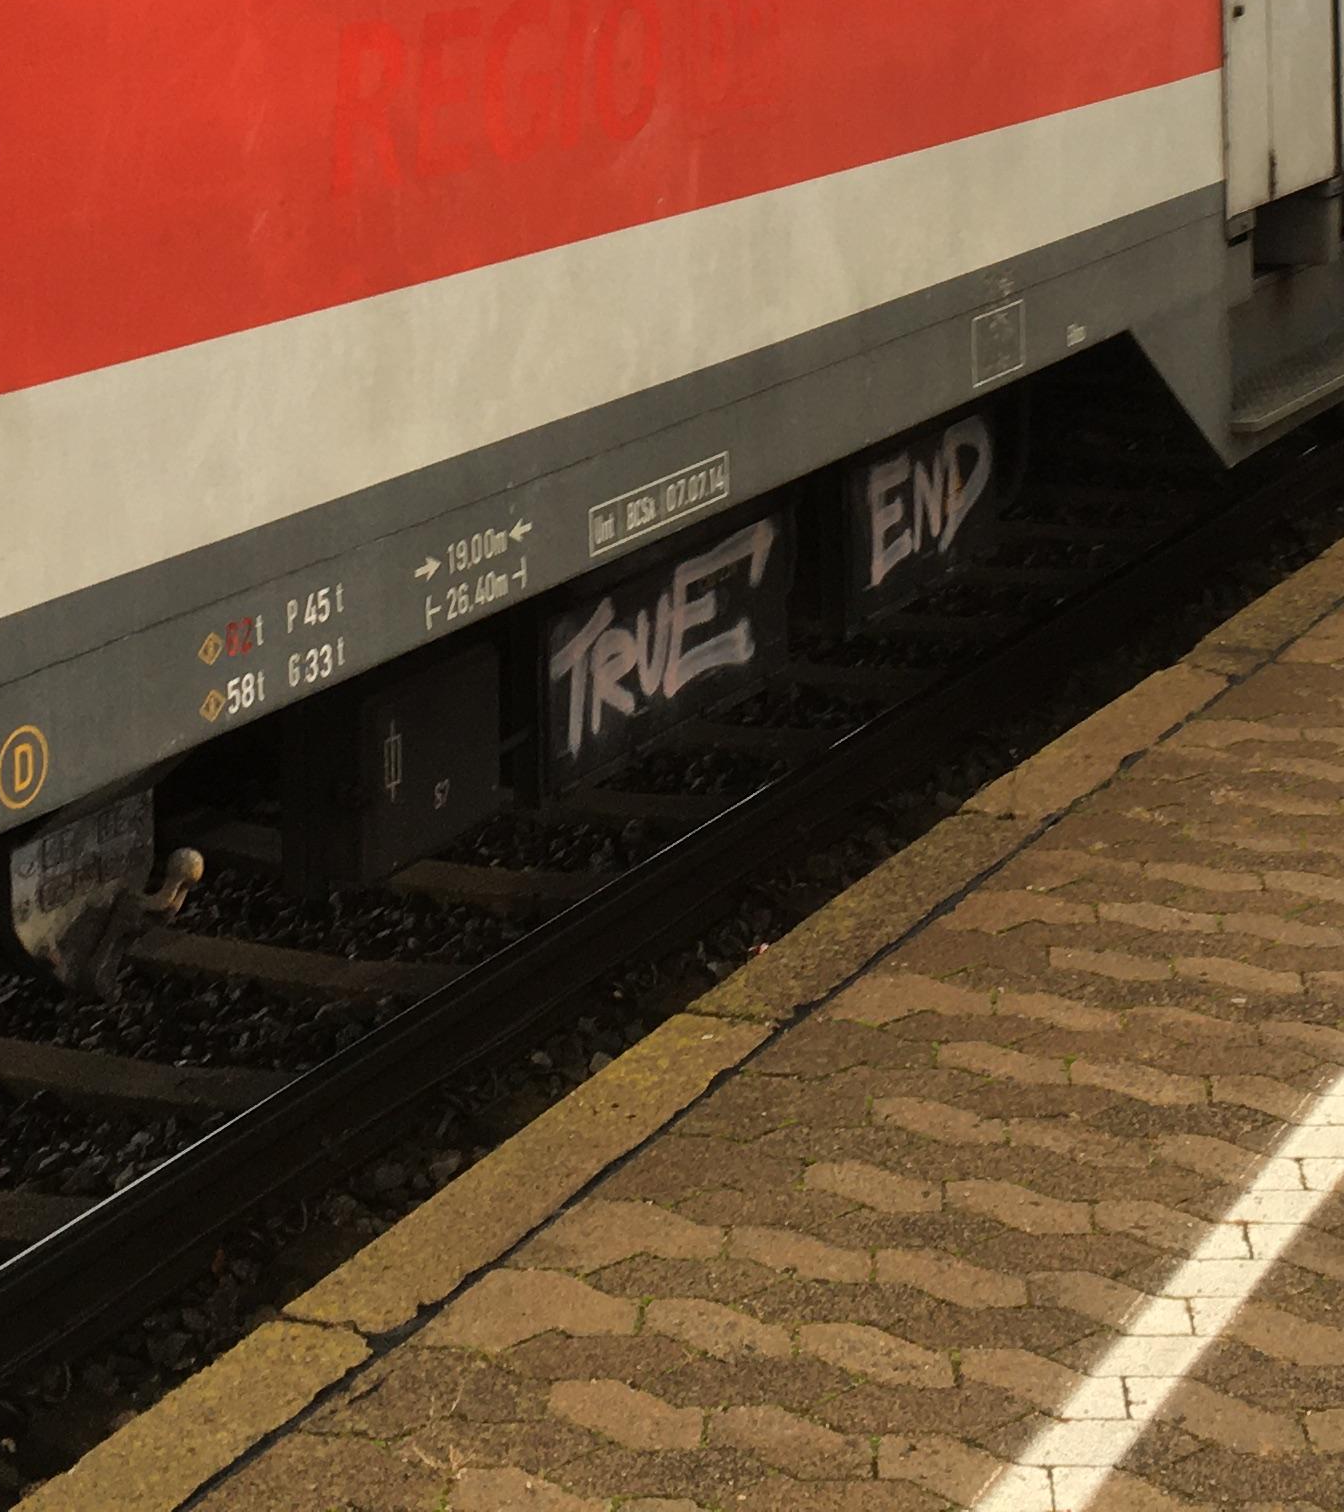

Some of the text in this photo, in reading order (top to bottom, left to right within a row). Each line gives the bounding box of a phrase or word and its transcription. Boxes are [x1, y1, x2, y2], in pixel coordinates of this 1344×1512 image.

[866, 414, 993, 588] END
[549, 516, 776, 760] TRUE
[14, 742, 34, 793] D
